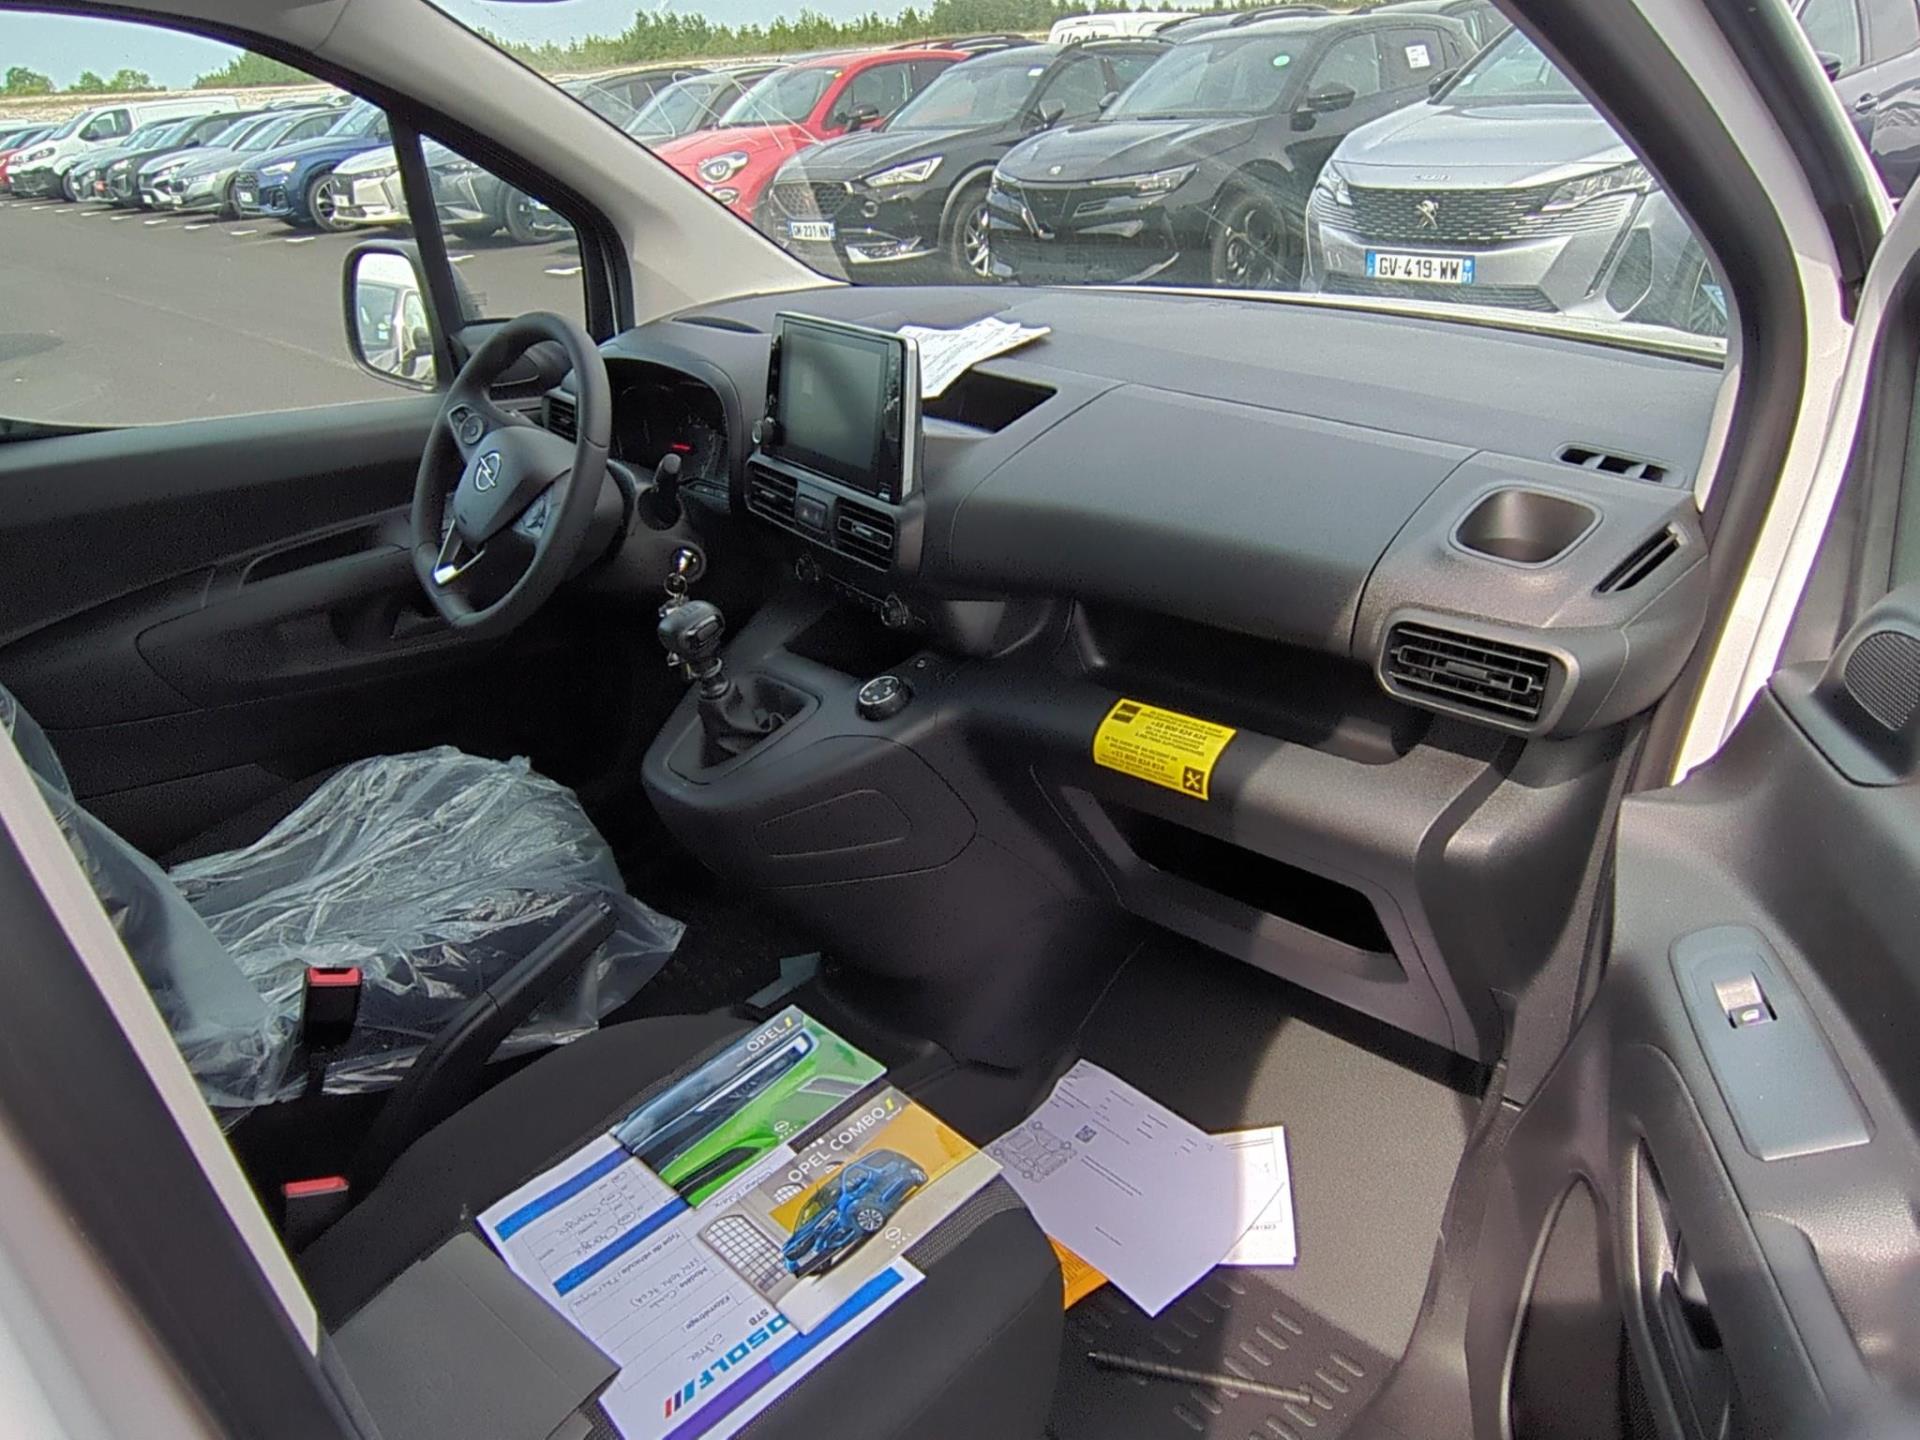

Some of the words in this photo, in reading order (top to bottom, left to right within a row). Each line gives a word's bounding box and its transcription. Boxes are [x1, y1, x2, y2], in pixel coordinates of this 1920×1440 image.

[1379, 257, 1459, 281] GV-419-WW
[747, 1025, 785, 1051] OPEL
[788, 1152, 831, 1183] OPEL
[830, 1106, 885, 1150] COMBO
